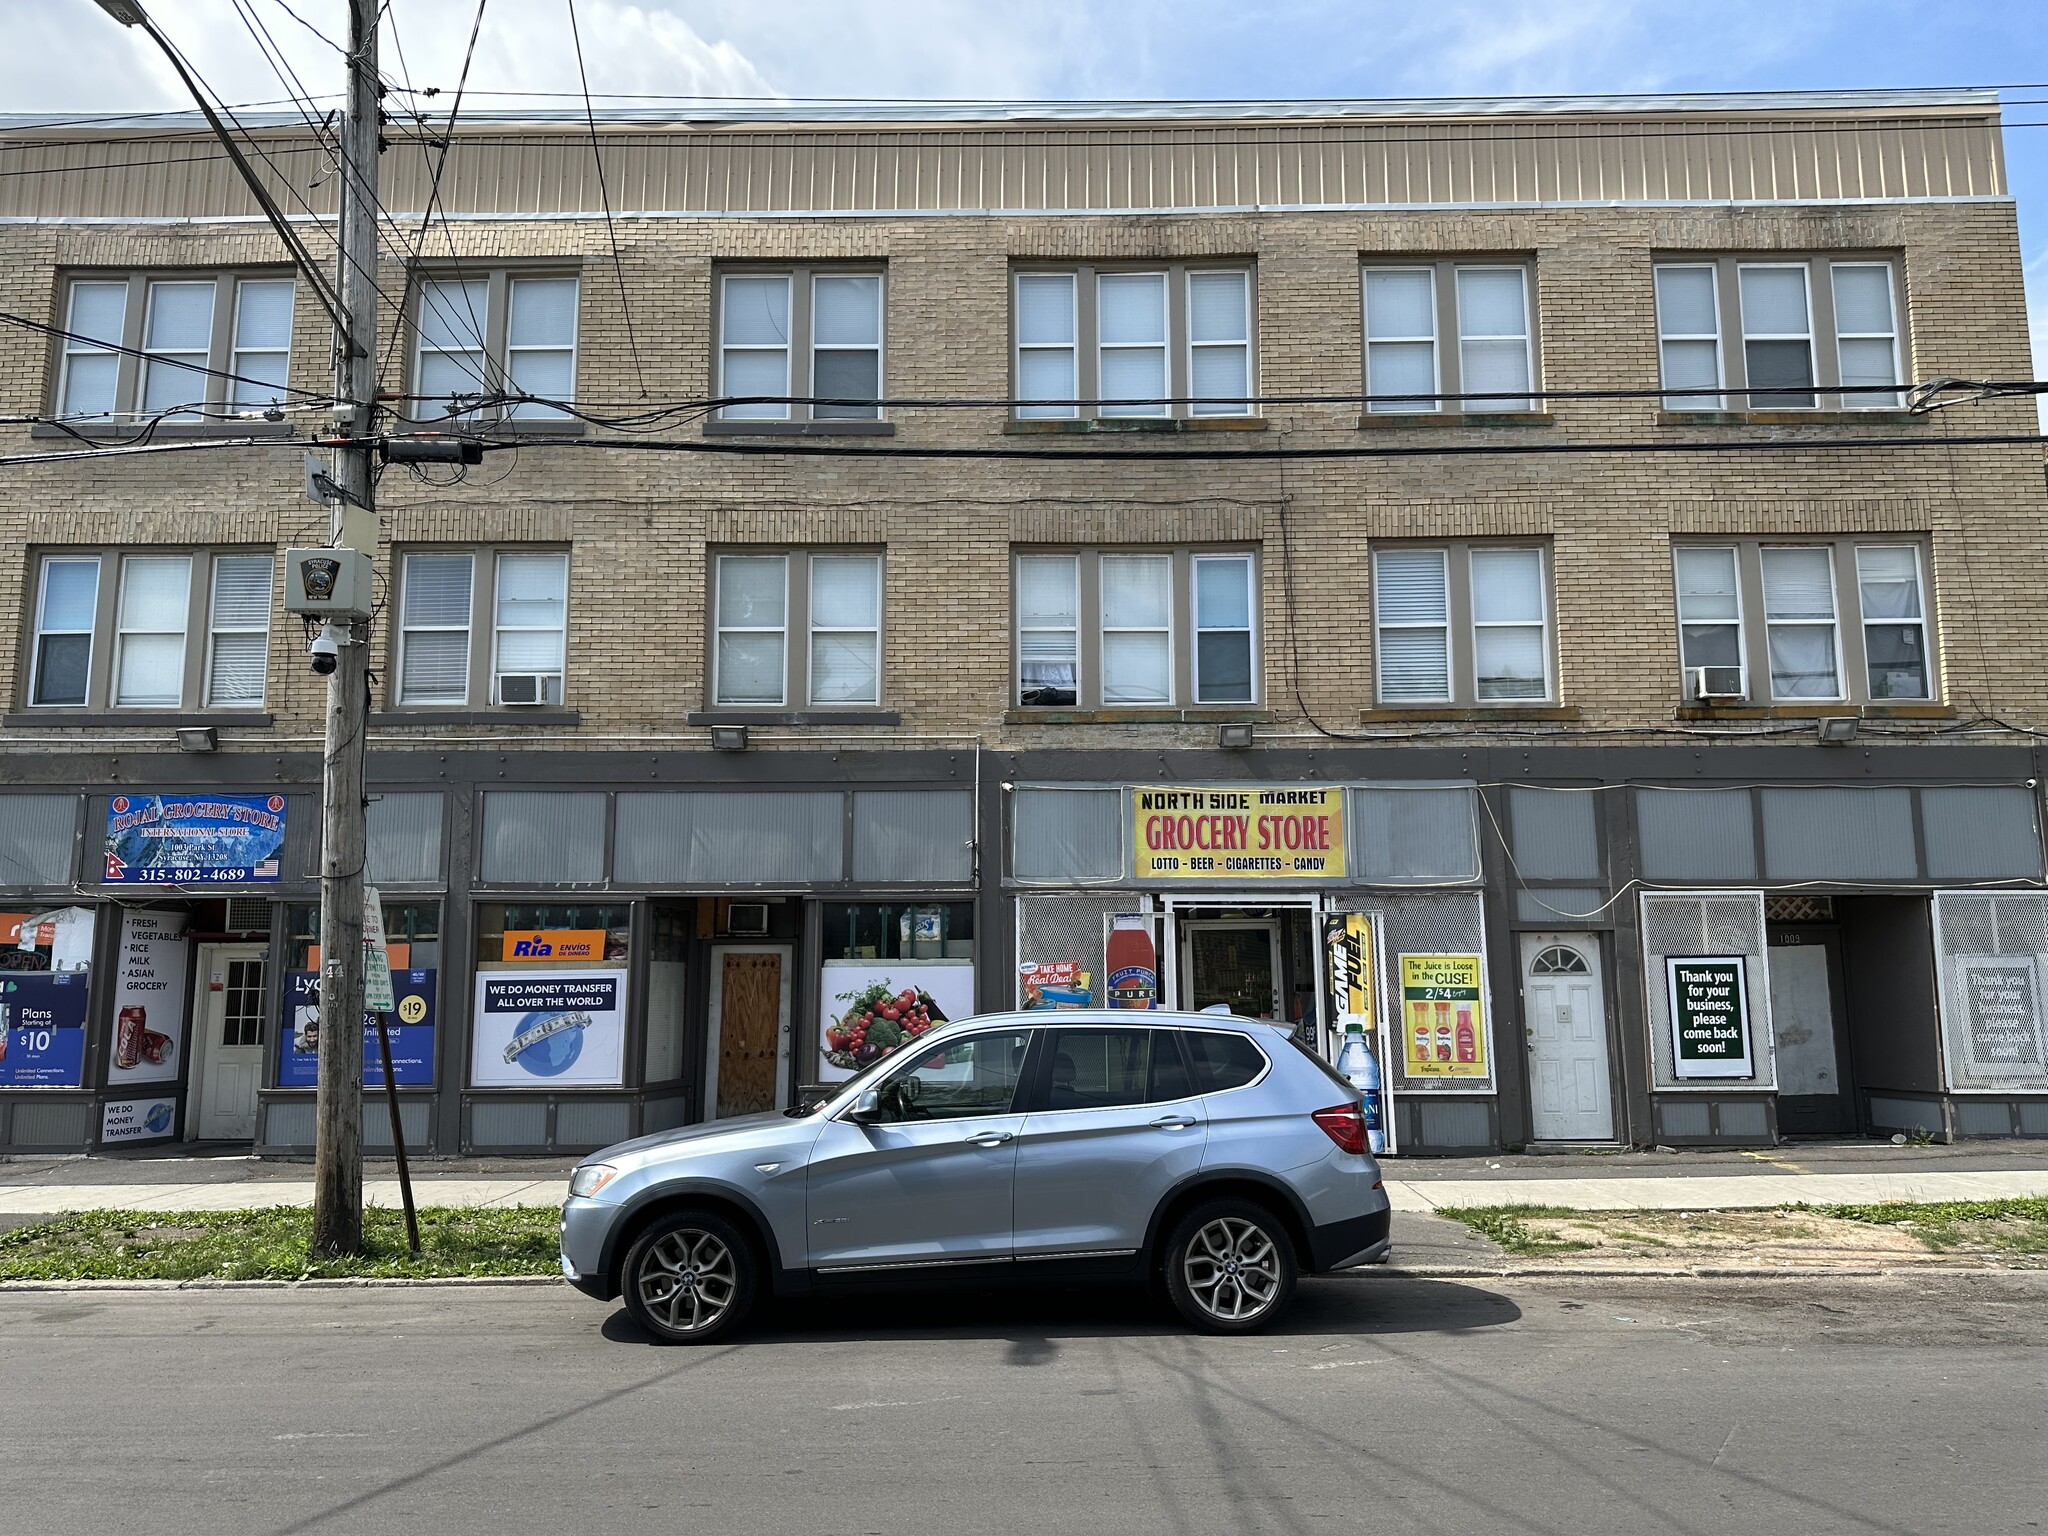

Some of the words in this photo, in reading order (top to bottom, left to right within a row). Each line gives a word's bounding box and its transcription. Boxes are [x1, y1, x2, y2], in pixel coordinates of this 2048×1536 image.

[1142, 793, 1204, 810] NORTH
[1210, 793, 1250, 810] SIDE
[1259, 791, 1327, 804] MARKET
[113, 807, 160, 832] ROJAL
[162, 802, 233, 819] GROCERY
[234, 807, 280, 832] STORE
[140, 827, 216, 837] INTERNATIONAL
[217, 827, 250, 837] STORE
[1146, 815, 1250, 850] GROCERY
[1258, 815, 1330, 850] STORE
[158, 853, 191, 862] Syracuse,
[207, 853, 228, 861] 13208
[1151, 857, 1179, 870] LOTTO
[1190, 857, 1214, 870] BEER
[1226, 857, 1282, 870] CIGARETTES
[1294, 857, 1325, 870] CANDY
[131, 919, 158, 928] FRESH
[131, 931, 183, 942] VEGETABLES
[1780, 934, 1800, 943] 1009
[130, 944, 149, 952] RICE
[514, 935, 552, 957] Ria
[560, 943, 591, 951] ENVÍOS
[0, 952, 43, 971] OPEN
[128, 957, 151, 965] MILK
[1346, 929, 1363, 992] FUEL
[1408, 961, 1421, 970] The
[1423, 961, 1442, 970] Juice
[1444, 962, 1451, 970] is
[1453, 961, 1473, 970] Loose
[127, 969, 155, 978] ASIAN
[1040, 965, 1055, 974] TAKE
[1055, 963, 1073, 973] HOME
[1027, 974, 1050, 985] Real
[1050, 972, 1073, 984] Deal
[1112, 969, 1133, 981] FRUIT
[1136, 969, 1155, 980] PUNCH
[1333, 943, 1349, 1014] GAME
[1412, 972, 1420, 980] in
[1421, 972, 1434, 980] the
[1435, 973, 1473, 985] CUSE!
[1680, 970, 1713, 983] Thank
[1714, 973, 1733, 985] you
[1971, 973, 2003, 986] Thank
[2005, 976, 2025, 988] you
[126, 981, 168, 991] GROCERY
[490, 985, 506, 994] WE
[508, 985, 523, 994] DO
[525, 984, 562, 994] MONEY
[563, 984, 613, 993] TRANSFER
[1114, 990, 1154, 998] PURE
[1425, 987, 1452, 1000] 2/$4
[1688, 985, 1703, 997] for
[1707, 987, 1730, 1000] your
[497, 998, 515, 1007] ALL
[516, 998, 544, 1007] OVER
[545, 998, 564, 1006] THE
[566, 997, 603, 1006] WORLD
[1687, 999, 1734, 1013] business,
[22, 1008, 52, 1019] Plans
[403, 1002, 422, 1015] $19
[1693, 1013, 1727, 1027] please
[364, 1028, 401, 1036] Unlited
[1683, 1029, 1712, 1039] come
[1714, 1027, 1738, 1039] back
[20, 1031, 50, 1051] $10
[118, 1020, 137, 1057] COLA
[1697, 1041, 1726, 1053] soon!
[108, 1106, 120, 1114] WE
[121, 1105, 133, 1113] DO
[106, 1116, 134, 1125] MONEY
[106, 1126, 142, 1136] TRANSFER
